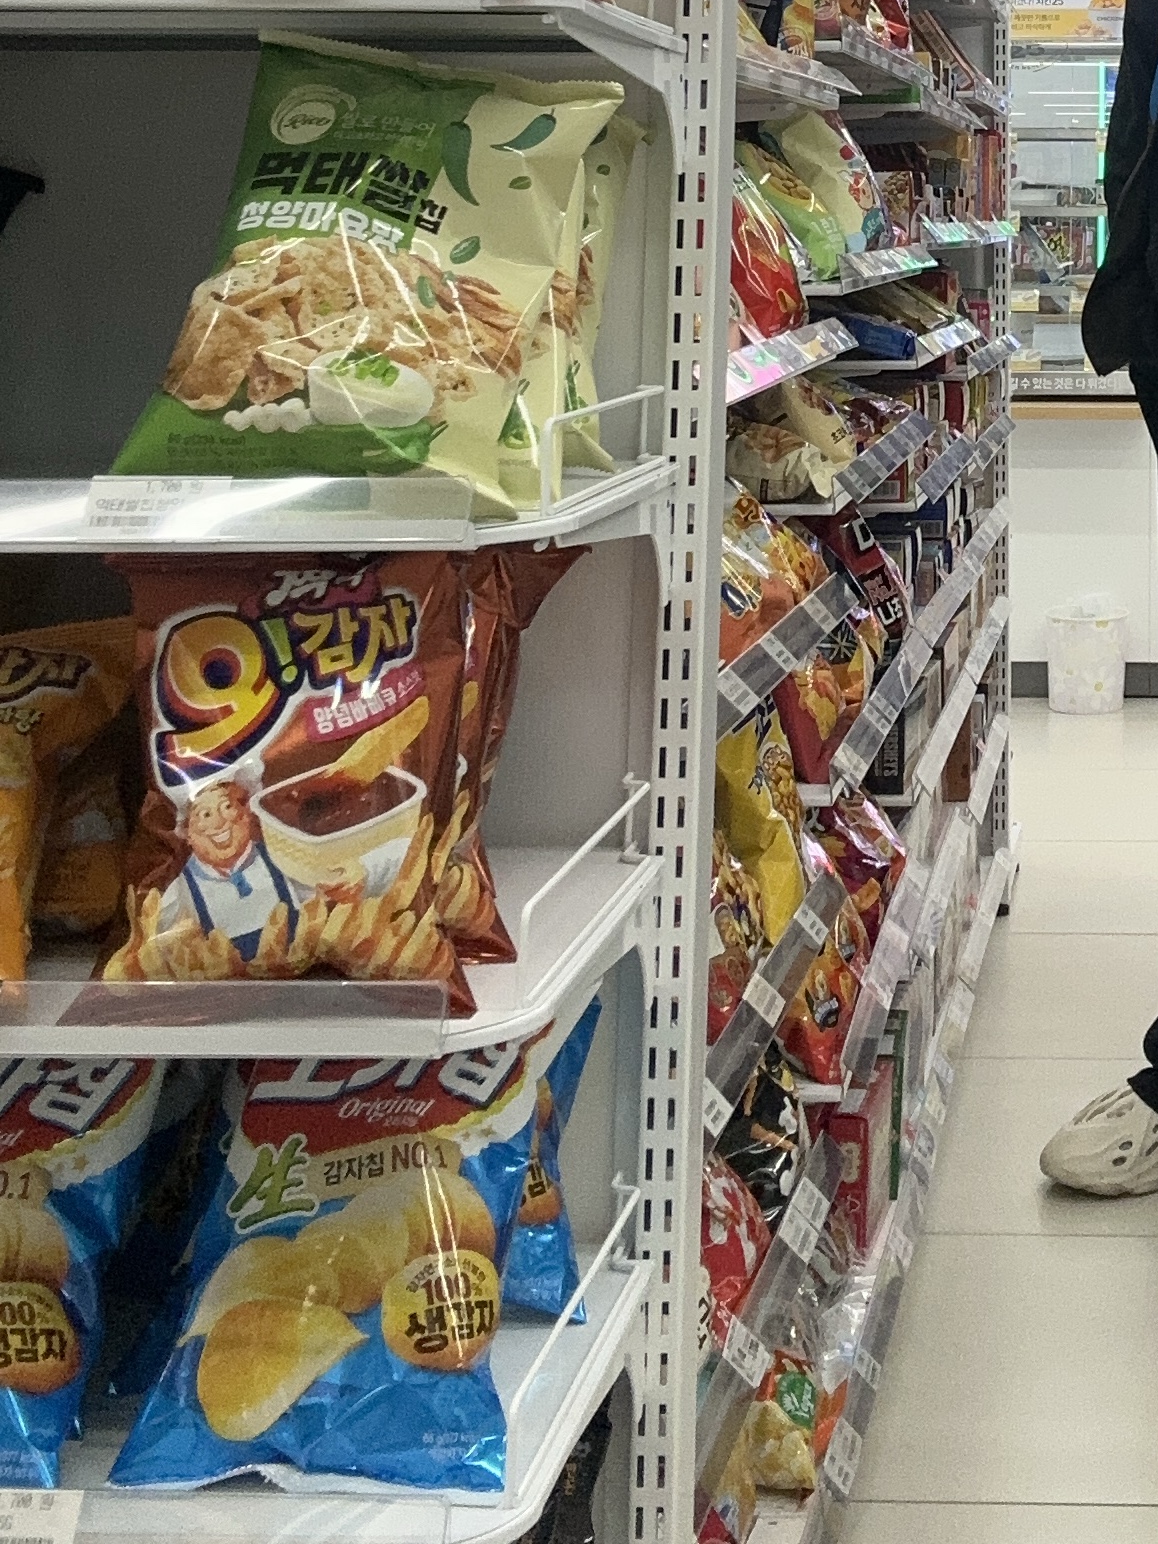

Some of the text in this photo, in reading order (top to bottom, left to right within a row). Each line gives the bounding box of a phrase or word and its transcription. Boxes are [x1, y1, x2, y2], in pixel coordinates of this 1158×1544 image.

[1035, 14, 1061, 22] 기름으로
[237, 201, 404, 254] 청양마요맛
[1020, 377, 1031, 390] 수
[1032, 377, 1053, 390] 있는
[1054, 377, 1075, 390] 것은
[1075, 377, 1086, 390] 다
[338, 1097, 435, 1124] Original
[231, 1137, 316, 1230] 生
[323, 1140, 449, 1186] 감자칩 NO.1
[405, 1299, 495, 1354] 생감자
